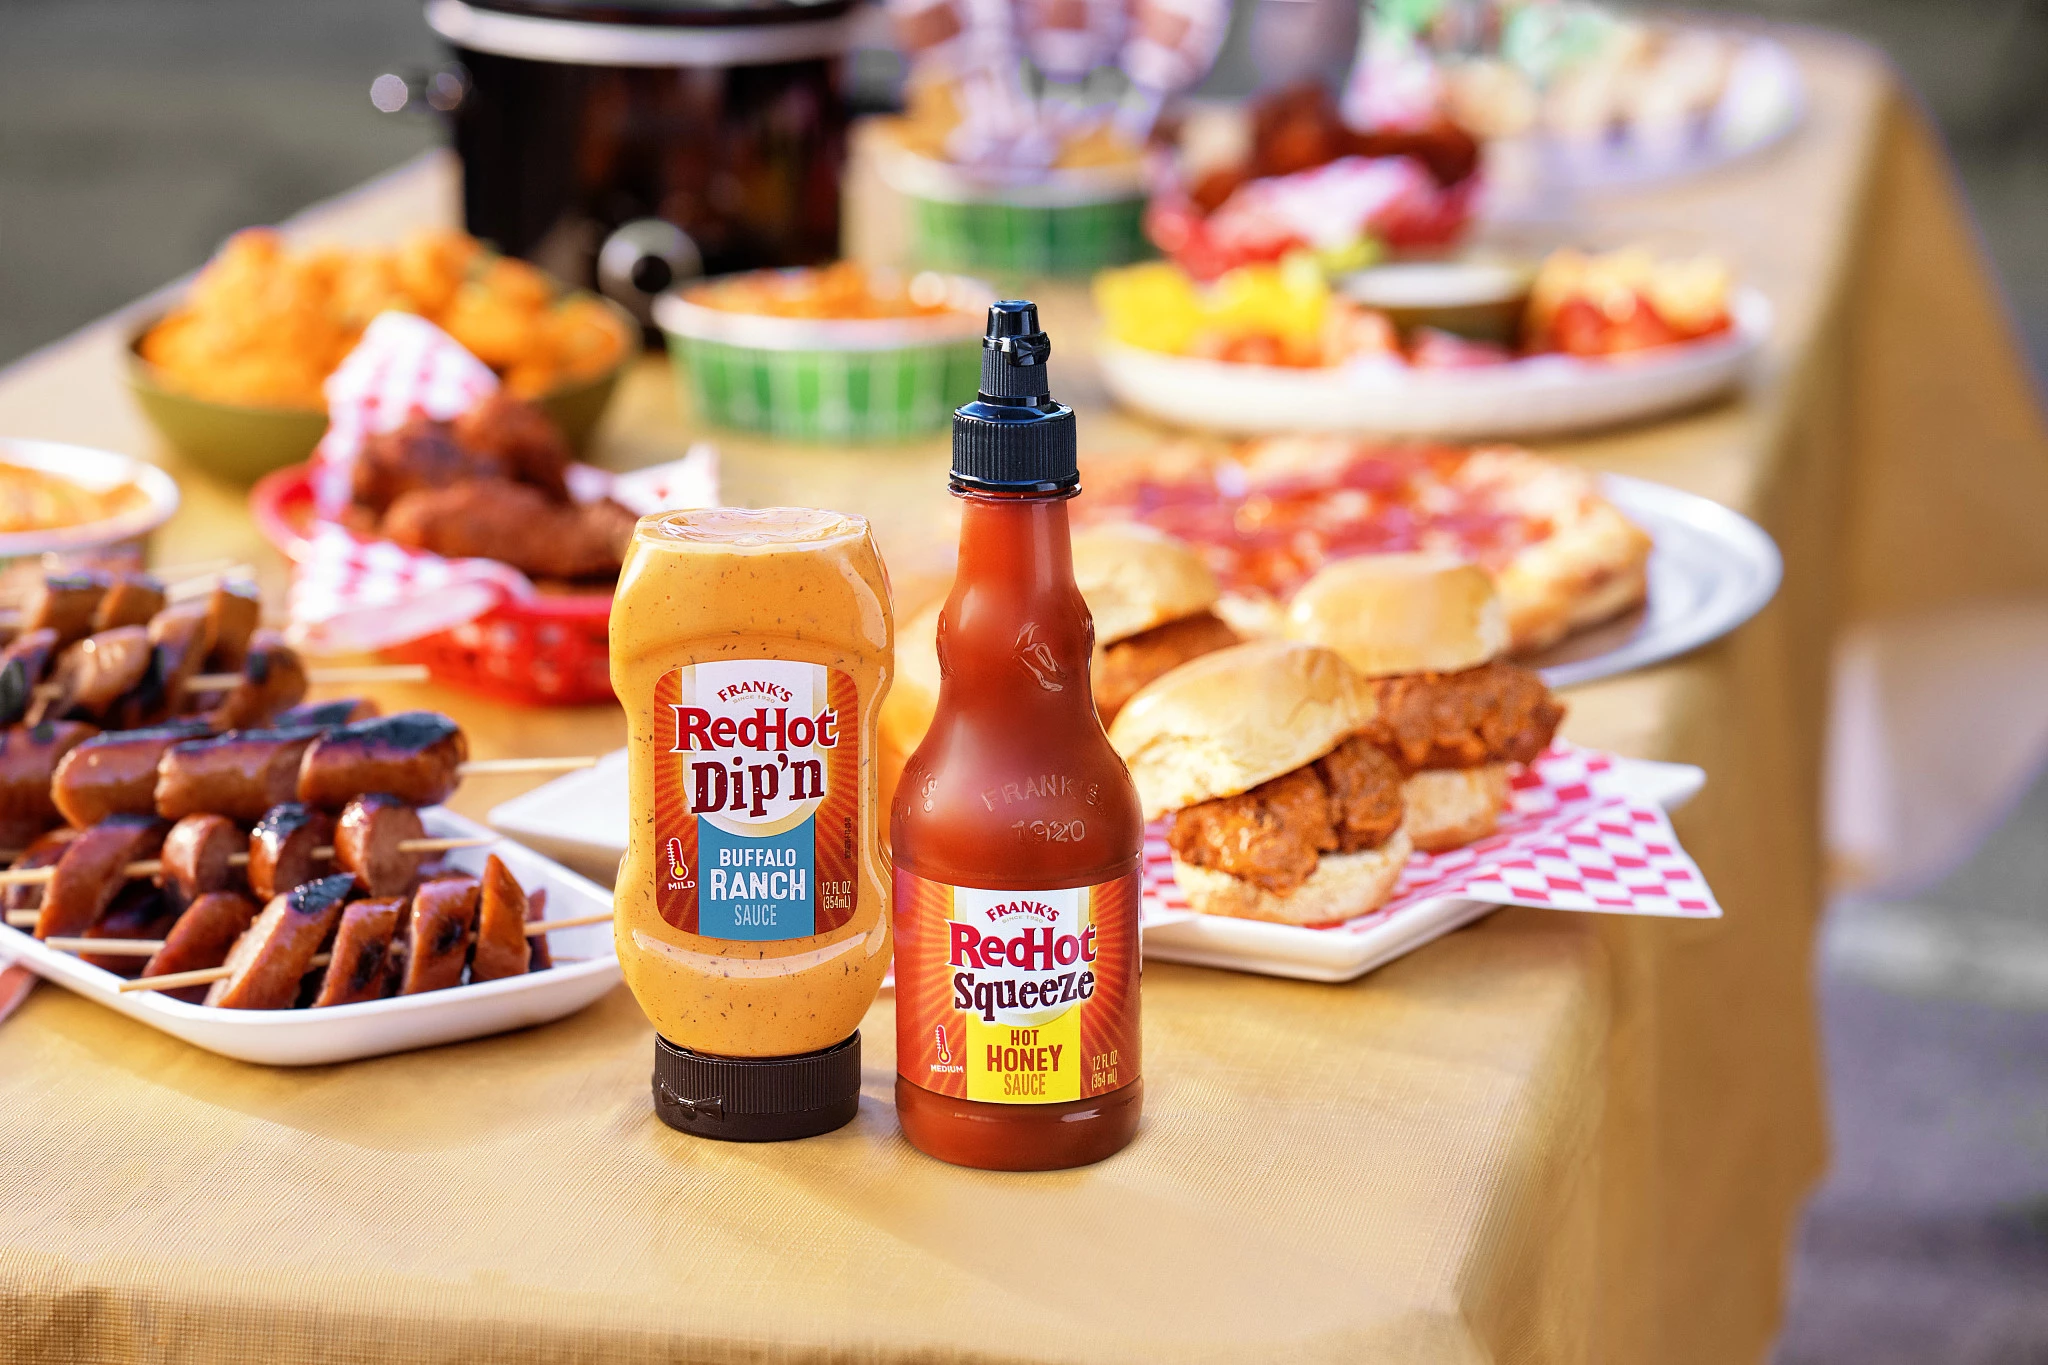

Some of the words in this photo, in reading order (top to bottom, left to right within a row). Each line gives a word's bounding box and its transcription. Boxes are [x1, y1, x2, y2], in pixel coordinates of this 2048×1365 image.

[717, 681, 793, 702] FRANK'S
[732, 694, 755, 705] SINCE
[674, 705, 838, 751] RedHot
[691, 753, 825, 817] Dip'n
[719, 848, 797, 867] BUFFALO
[667, 880, 696, 891] MILD
[710, 868, 806, 901] RANCH
[821, 881, 831, 895] 12
[832, 881, 840, 895] FL
[842, 880, 851, 894] OZ
[734, 904, 777, 926] SAUCE
[985, 900, 1060, 922] FRANK'S
[1001, 915, 1023, 924] SINCE
[949, 921, 1097, 971] RedHot
[953, 970, 1095, 1022] Squeeze
[1010, 1029, 1039, 1046] HOT
[930, 1064, 964, 1073] MEDIUM
[986, 1044, 1063, 1073] HONEY
[1092, 1055, 1101, 1071] 12
[1102, 1052, 1109, 1069] FL
[1110, 1049, 1118, 1066] OZ
[1004, 1073, 1046, 1096] SAUCE
